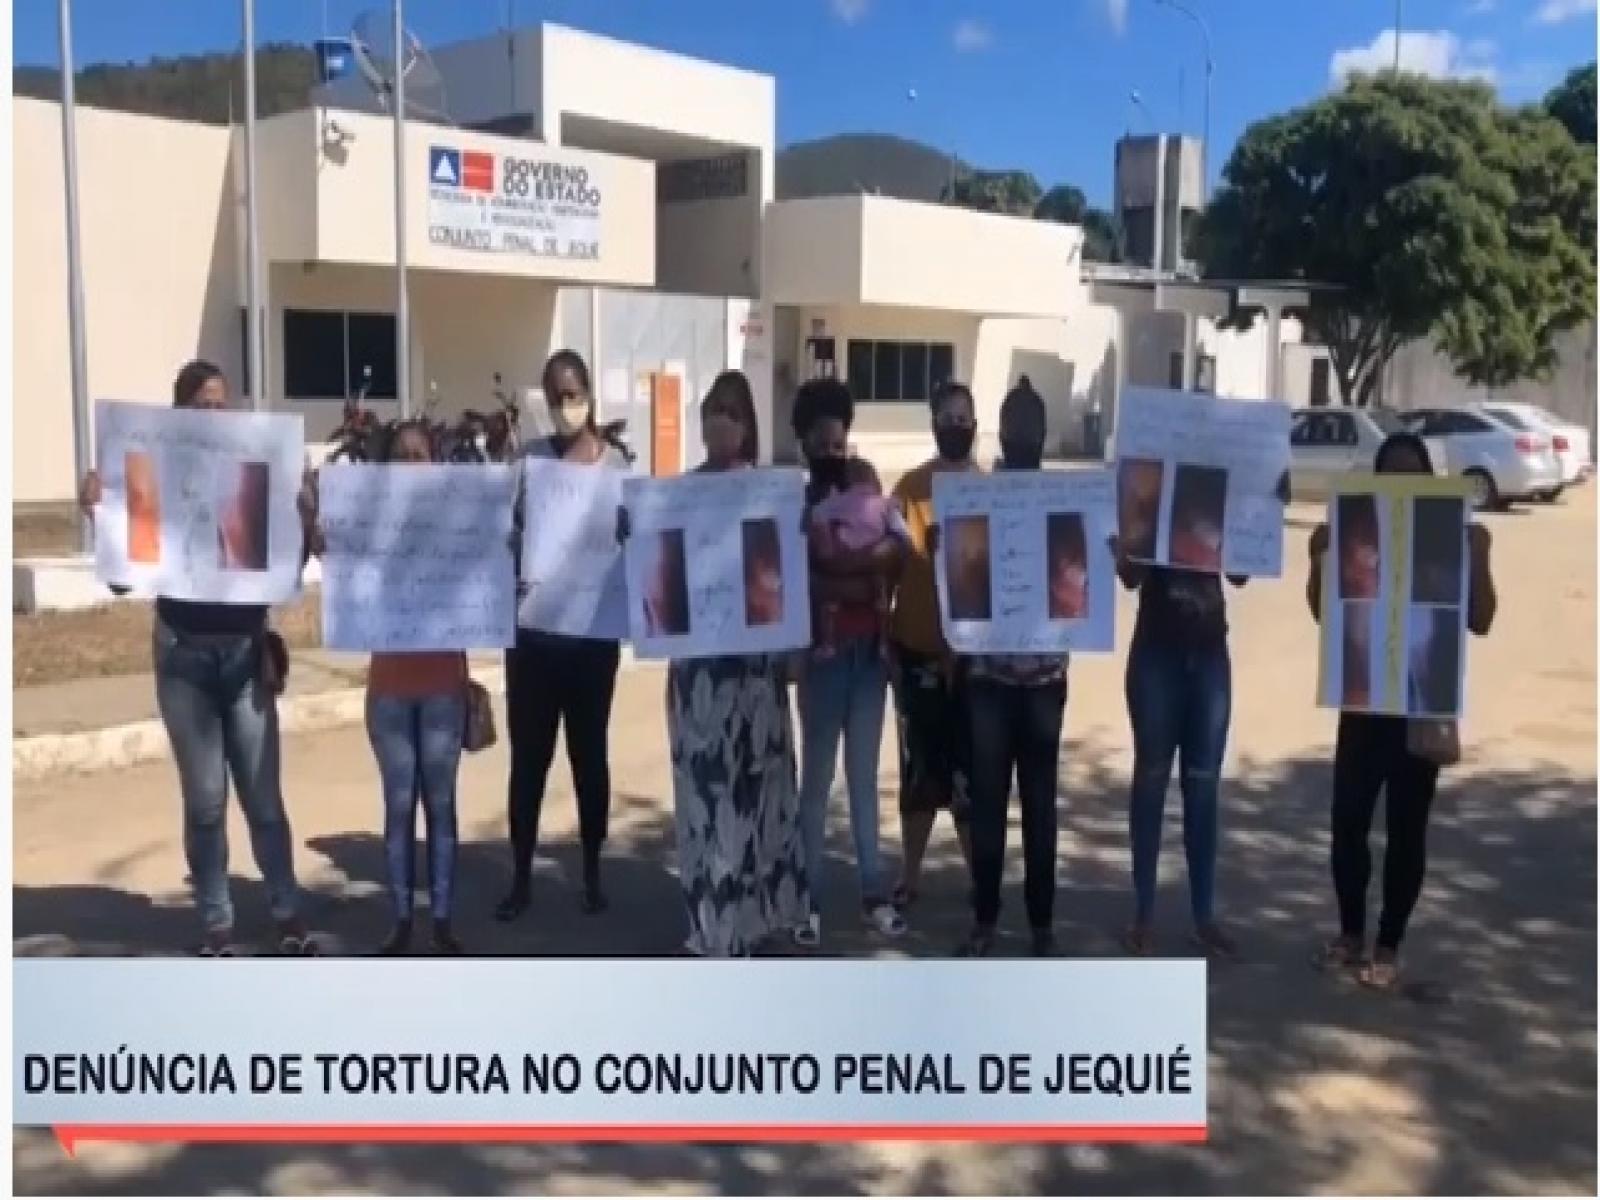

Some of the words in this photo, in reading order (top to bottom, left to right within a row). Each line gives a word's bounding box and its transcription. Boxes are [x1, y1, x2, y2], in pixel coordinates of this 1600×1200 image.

[503, 156, 588, 184] GOVERNO
[503, 176, 529, 196] DO
[536, 180, 601, 206] ESTADO
[429, 225, 491, 250] CONJUNTO
